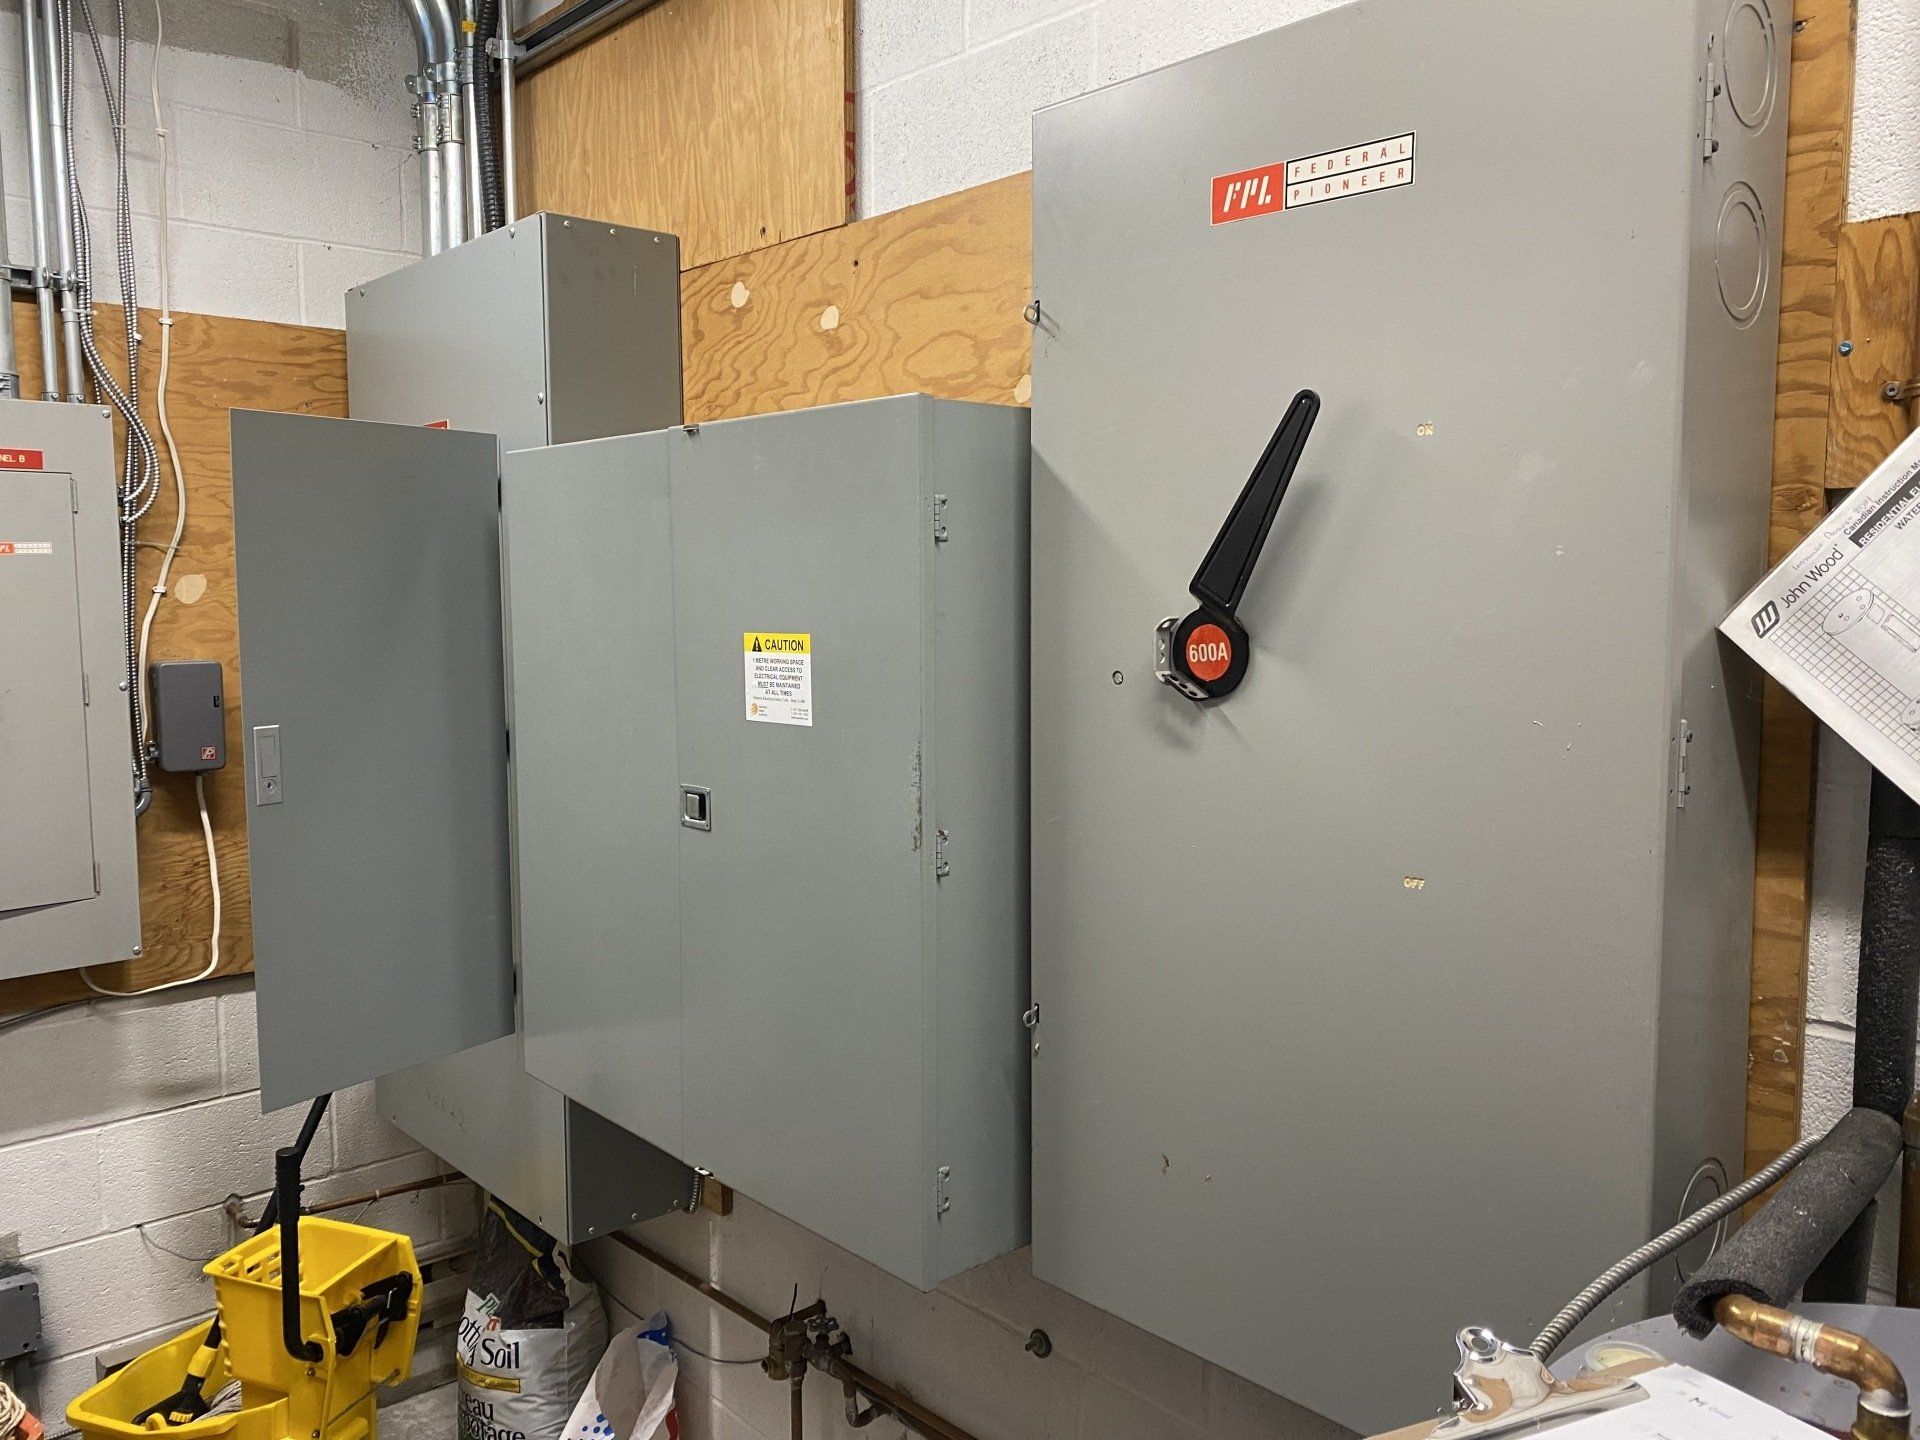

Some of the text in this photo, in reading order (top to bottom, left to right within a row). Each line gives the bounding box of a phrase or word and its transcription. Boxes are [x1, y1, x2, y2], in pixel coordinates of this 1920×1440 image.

[1294, 143, 1405, 178] FEDERAL
[1222, 175, 1272, 213] FPL
[1293, 167, 1405, 200] PIONEER
[1416, 423, 1434, 436] ON
[18, 454, 26, 463] B
[1843, 503, 1877, 536] Canadian
[1875, 471, 1913, 506] Instruction
[1858, 496, 1910, 545] RESIDENTIAL
[1781, 547, 1844, 609] John Wood
[764, 639, 804, 651] CAUTION
[1189, 642, 1229, 663] 600A
[1403, 876, 1425, 890] OFF
[481, 1338, 520, 1369] Soil
